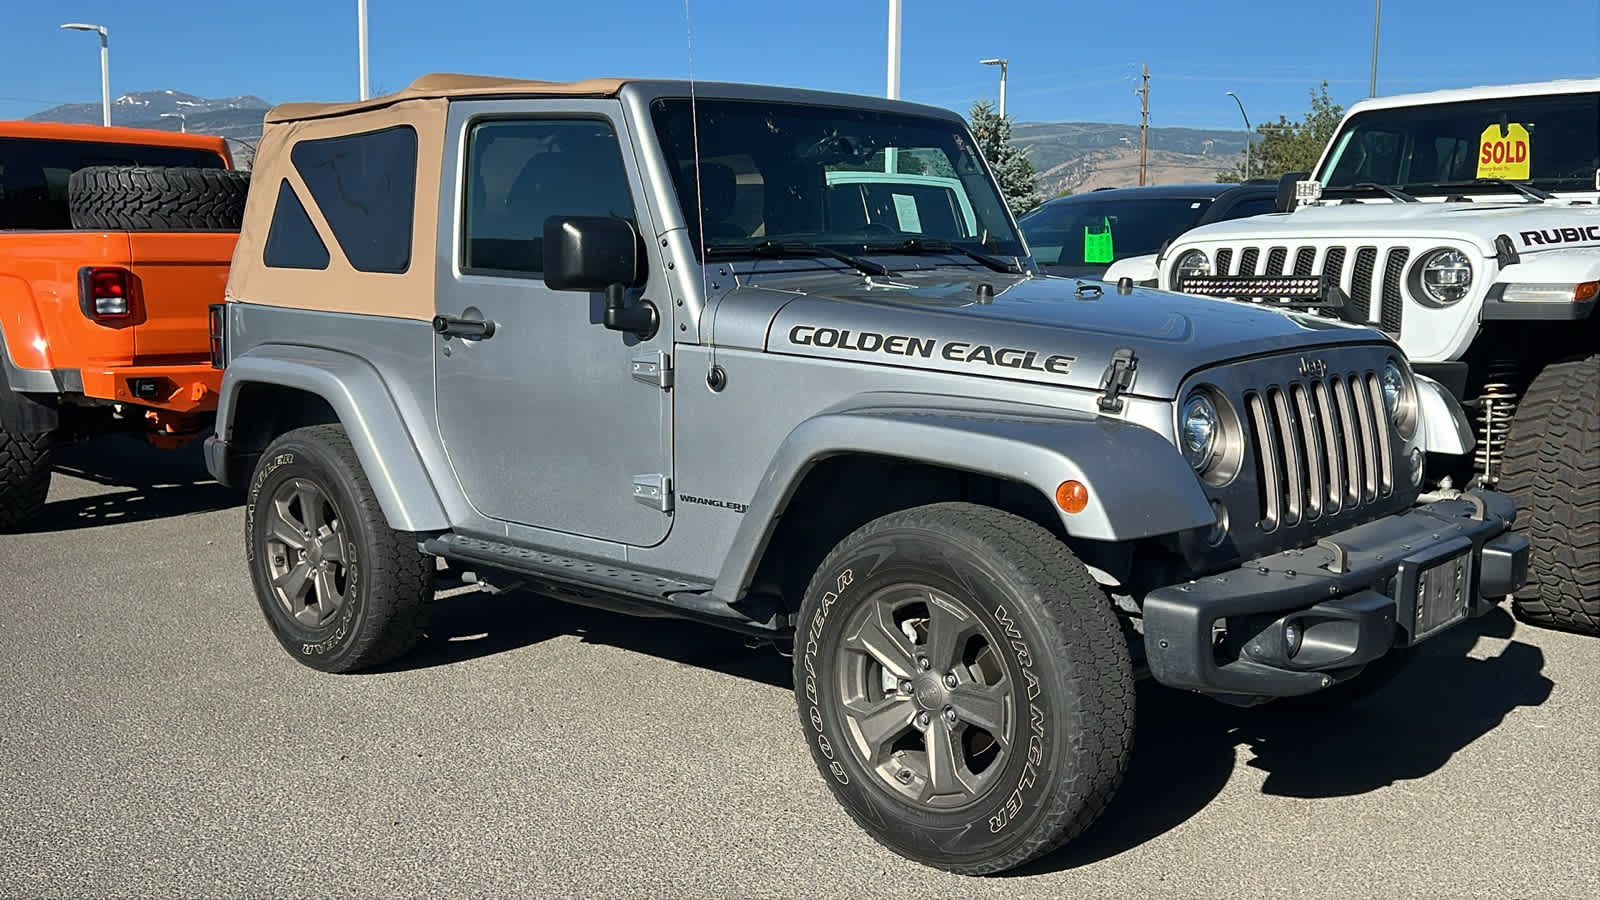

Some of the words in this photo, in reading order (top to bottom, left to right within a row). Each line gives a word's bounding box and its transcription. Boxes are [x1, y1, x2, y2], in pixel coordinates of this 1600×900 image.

[1481, 141, 1527, 164] SOLD
[788, 325, 937, 358] GOLDEN
[941, 341, 1075, 375] EAGLE
[1298, 357, 1327, 377] Jeep
[680, 494, 741, 511] WRANGLER
[805, 568, 854, 785] GOODYEAR
[988, 604, 1045, 833] WRANGLER
